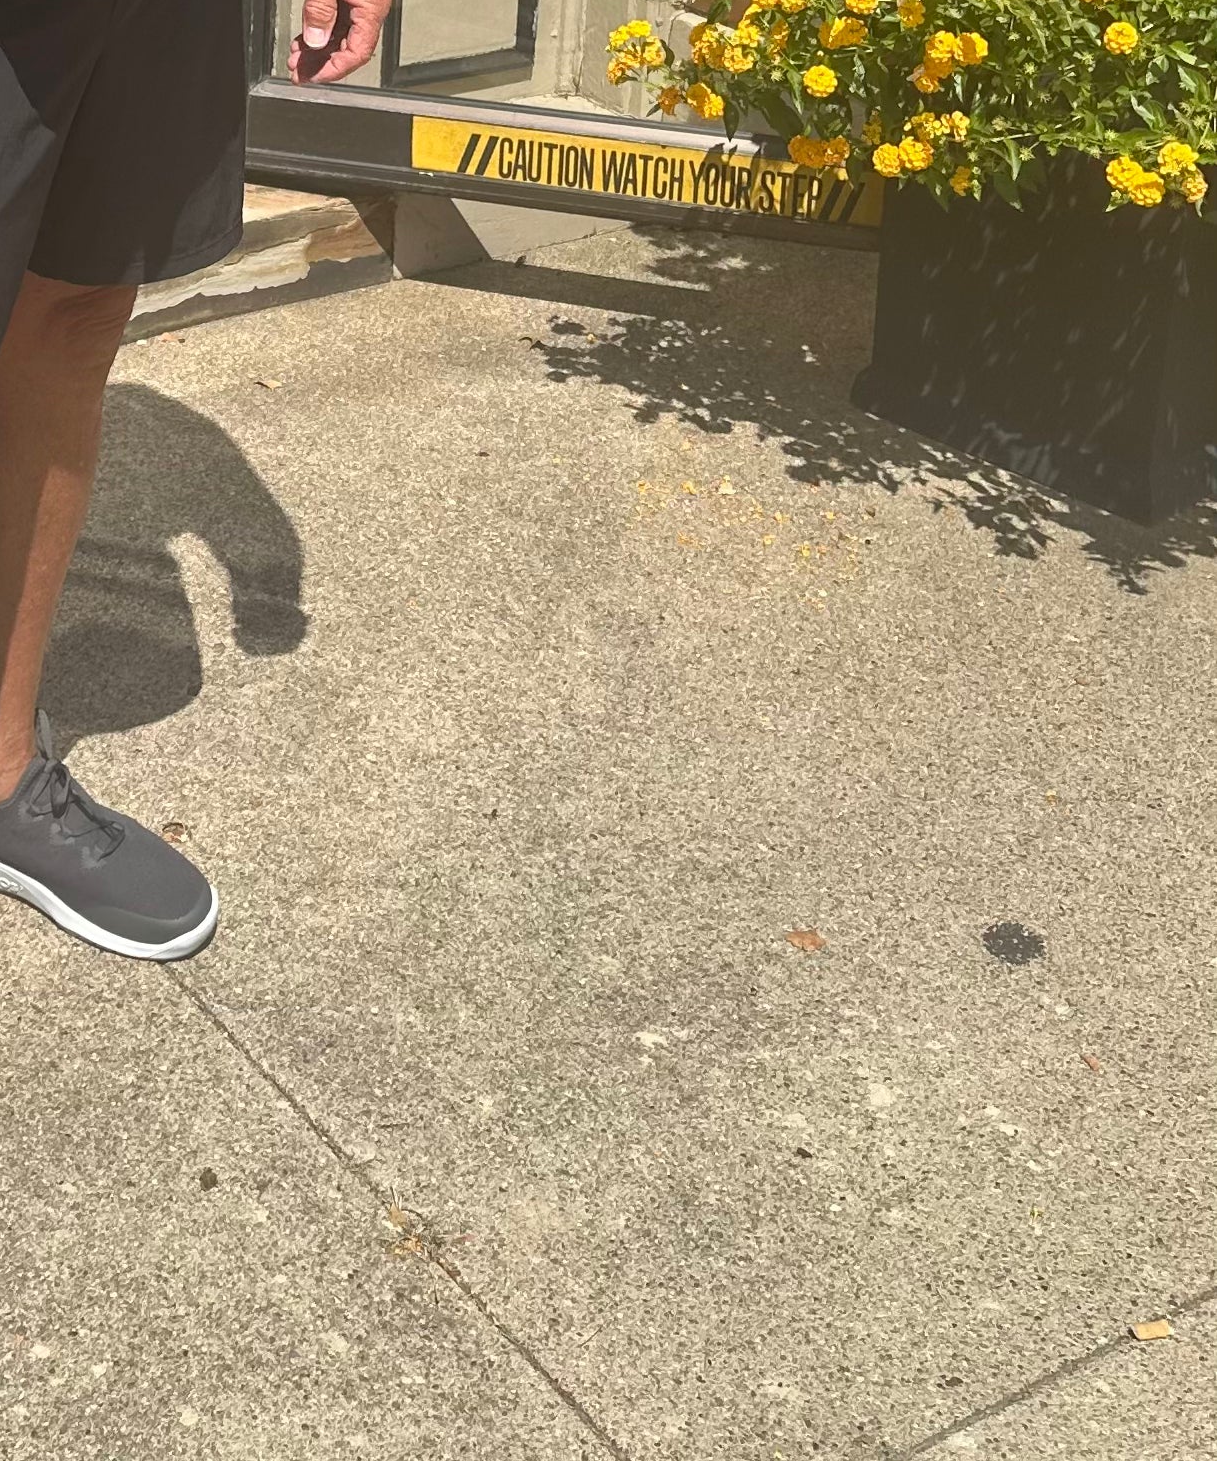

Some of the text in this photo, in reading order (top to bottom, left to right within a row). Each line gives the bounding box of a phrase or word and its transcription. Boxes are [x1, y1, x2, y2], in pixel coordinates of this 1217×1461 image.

[498, 137, 823, 221] CAUTION WATCH YOUR STEP
